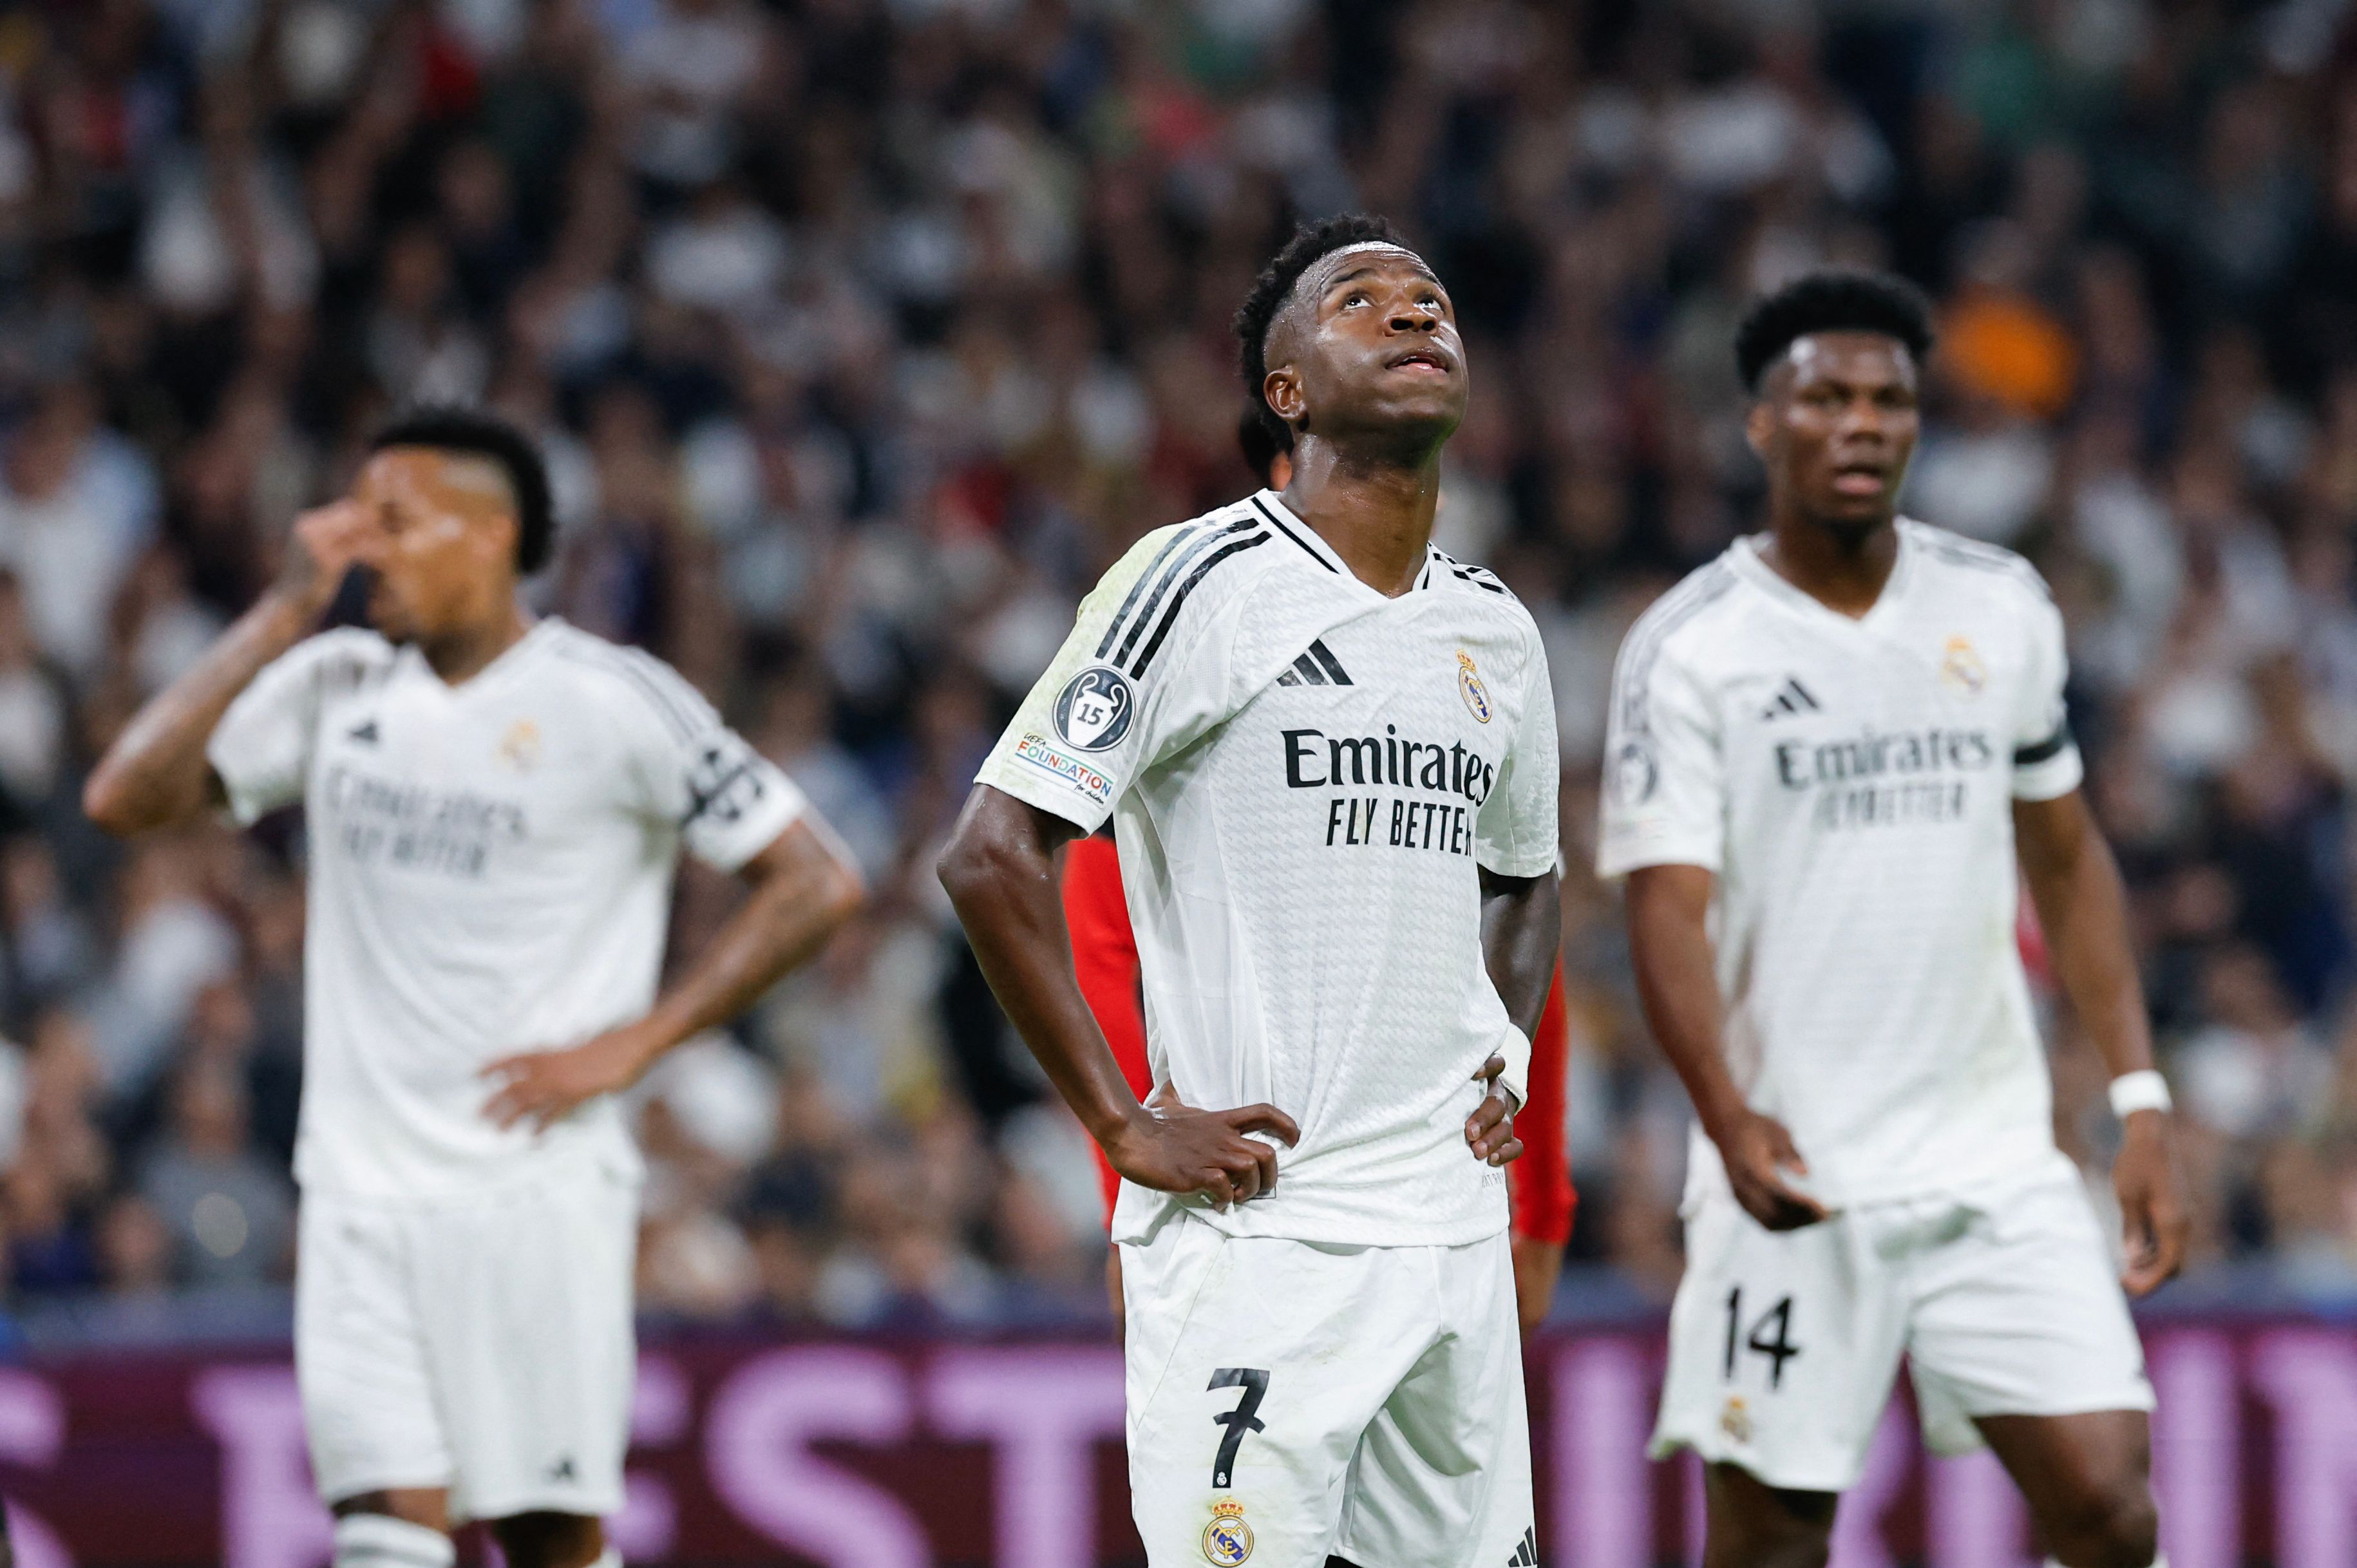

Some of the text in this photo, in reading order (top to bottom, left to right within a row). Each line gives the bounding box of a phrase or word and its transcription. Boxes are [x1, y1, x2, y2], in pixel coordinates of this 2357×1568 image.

[1024, 733, 1046, 747] UEFA
[1077, 703, 1104, 725] 15
[1280, 724, 1493, 807] Emirates
[1326, 798, 1378, 846] FLY
[1724, 1287, 1801, 1390] 14
[1206, 1368, 1271, 1489] 7
